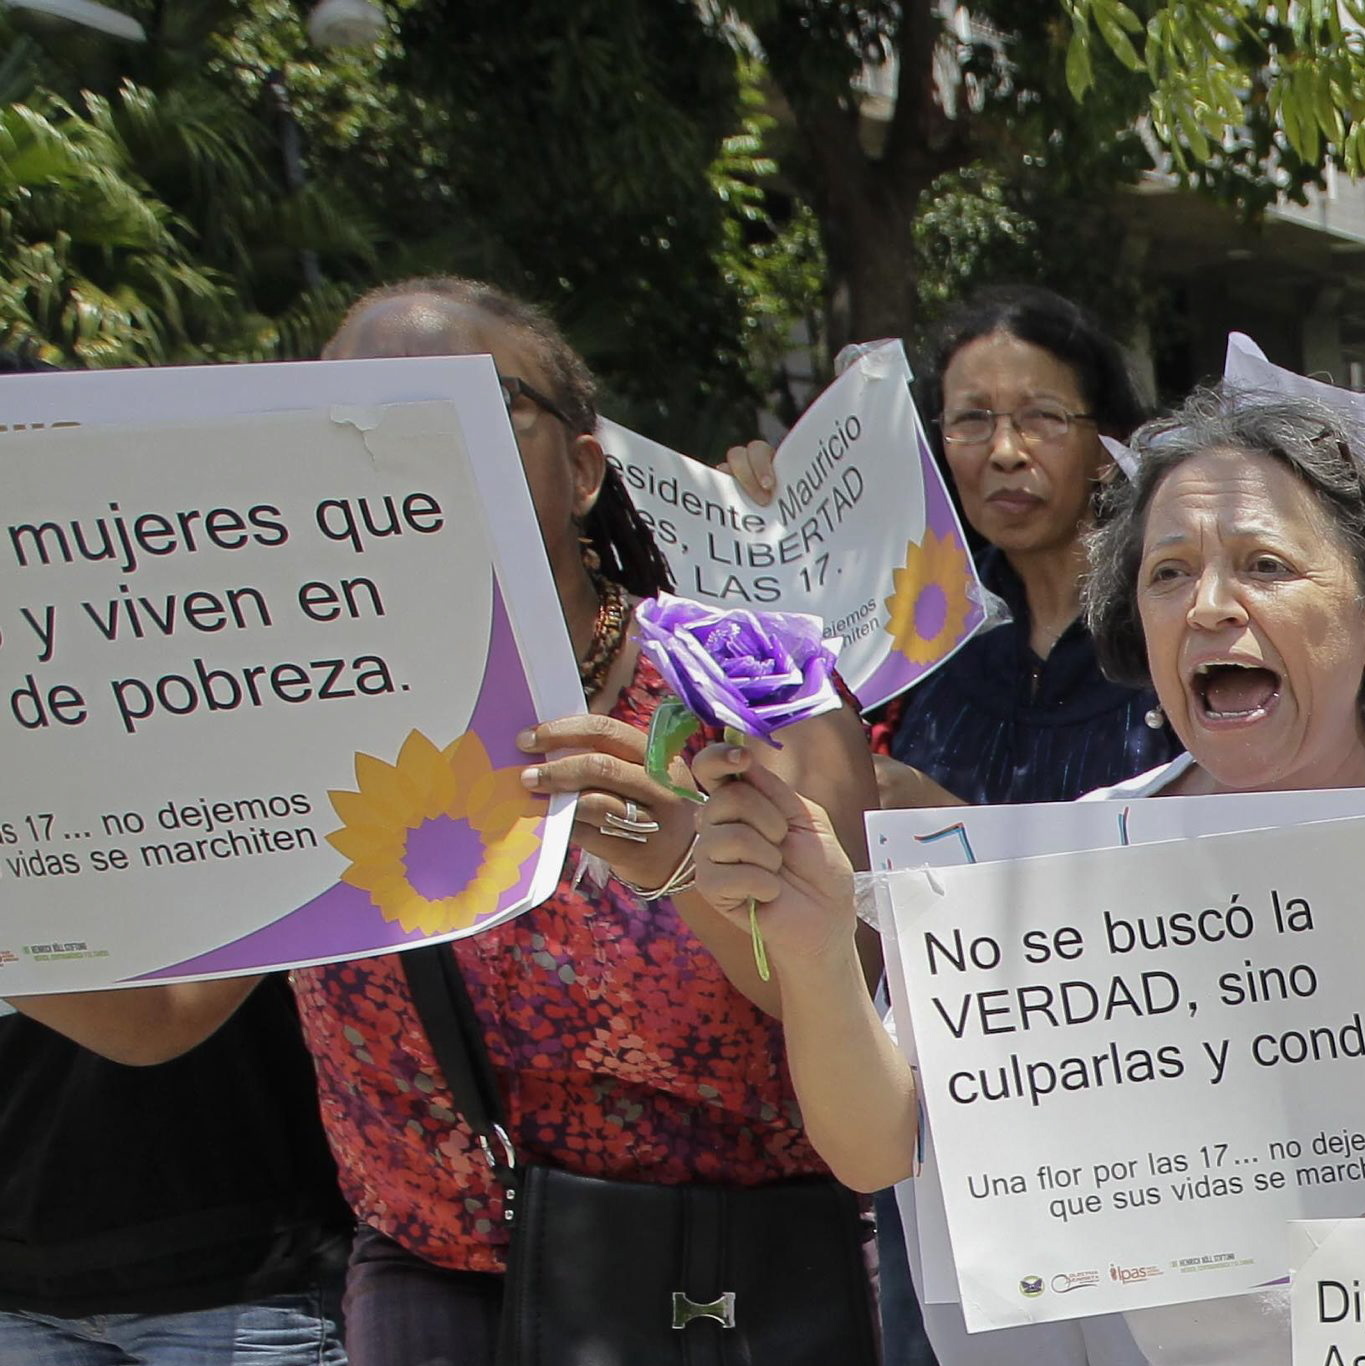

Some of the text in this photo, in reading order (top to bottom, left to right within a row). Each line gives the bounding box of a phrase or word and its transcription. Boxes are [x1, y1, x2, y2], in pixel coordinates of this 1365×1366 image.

[603, 413, 862, 533] esidente Mauricio
[7, 492, 444, 573] mujeres que
[707, 463, 865, 569] LIBERTAD
[695, 565, 782, 602] LAS
[799, 553, 843, 592] 17.
[19, 577, 385, 663] y viven en
[823, 598, 877, 640] ejemos
[10, 655, 410, 734] de pobreza.
[5, 827, 318, 878] vidas se marchiten
[25, 813, 91, 842] 17...
[101, 812, 145, 836] no
[158, 794, 311, 833] dejemos
[924, 890, 1314, 975] No se buscó la
[931, 959, 1318, 1039] VERDAD, sino
[948, 1041, 1185, 1107] culparlas
[1202, 1039, 1229, 1085] y
[967, 1173, 1027, 1199] Una
[1036, 1165, 1083, 1190] flor
[1093, 1160, 1138, 1189] por
[1148, 1152, 1189, 1176] las
[1200, 1143, 1258, 1169] 17...
[1269, 1140, 1302, 1160] no
[1049, 1195, 1102, 1223] que
[1112, 1187, 1162, 1210] sus
[1170, 1174, 1244, 1201] vidas
[1254, 1171, 1286, 1191] se
